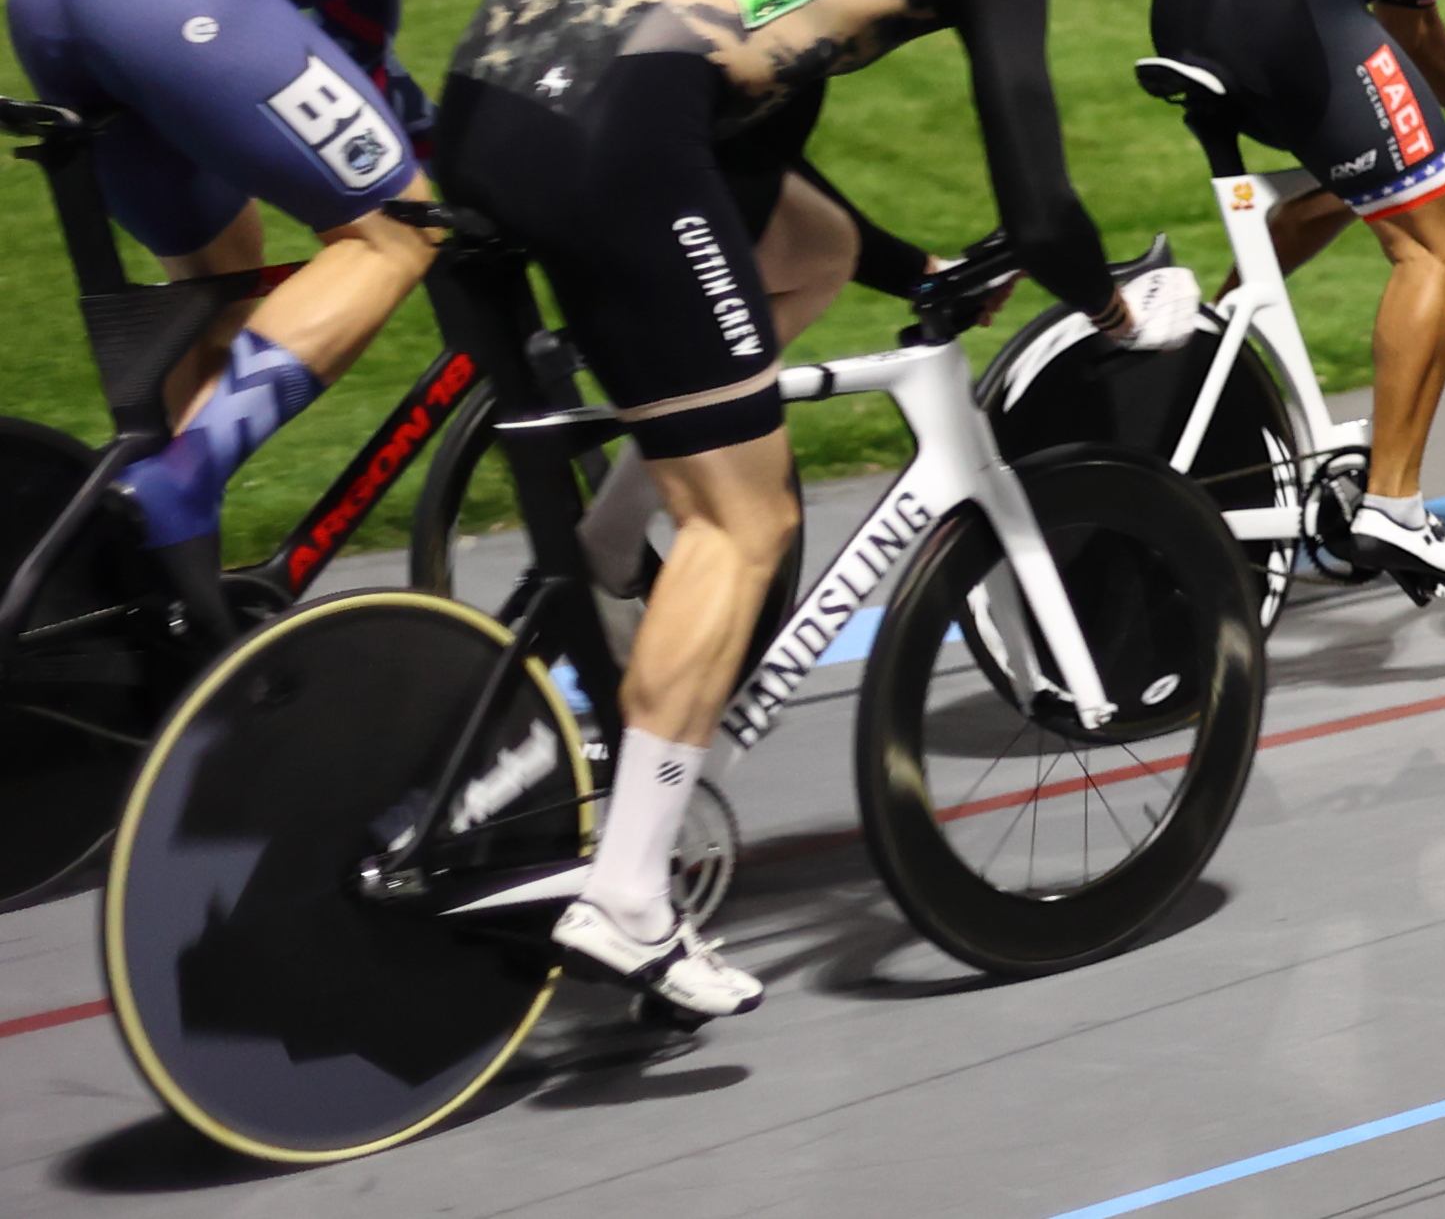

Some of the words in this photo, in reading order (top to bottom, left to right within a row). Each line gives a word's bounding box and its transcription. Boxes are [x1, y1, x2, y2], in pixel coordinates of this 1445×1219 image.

[1355, 64, 1391, 131] CYCLING
[1371, 50, 1430, 155] PACT
[671, 215, 738, 297] CUTTIN
[712, 297, 764, 357] CREW
[288, 405, 432, 591] ARGON
[426, 353, 476, 407] 18
[720, 491, 933, 752] HANDSLING
